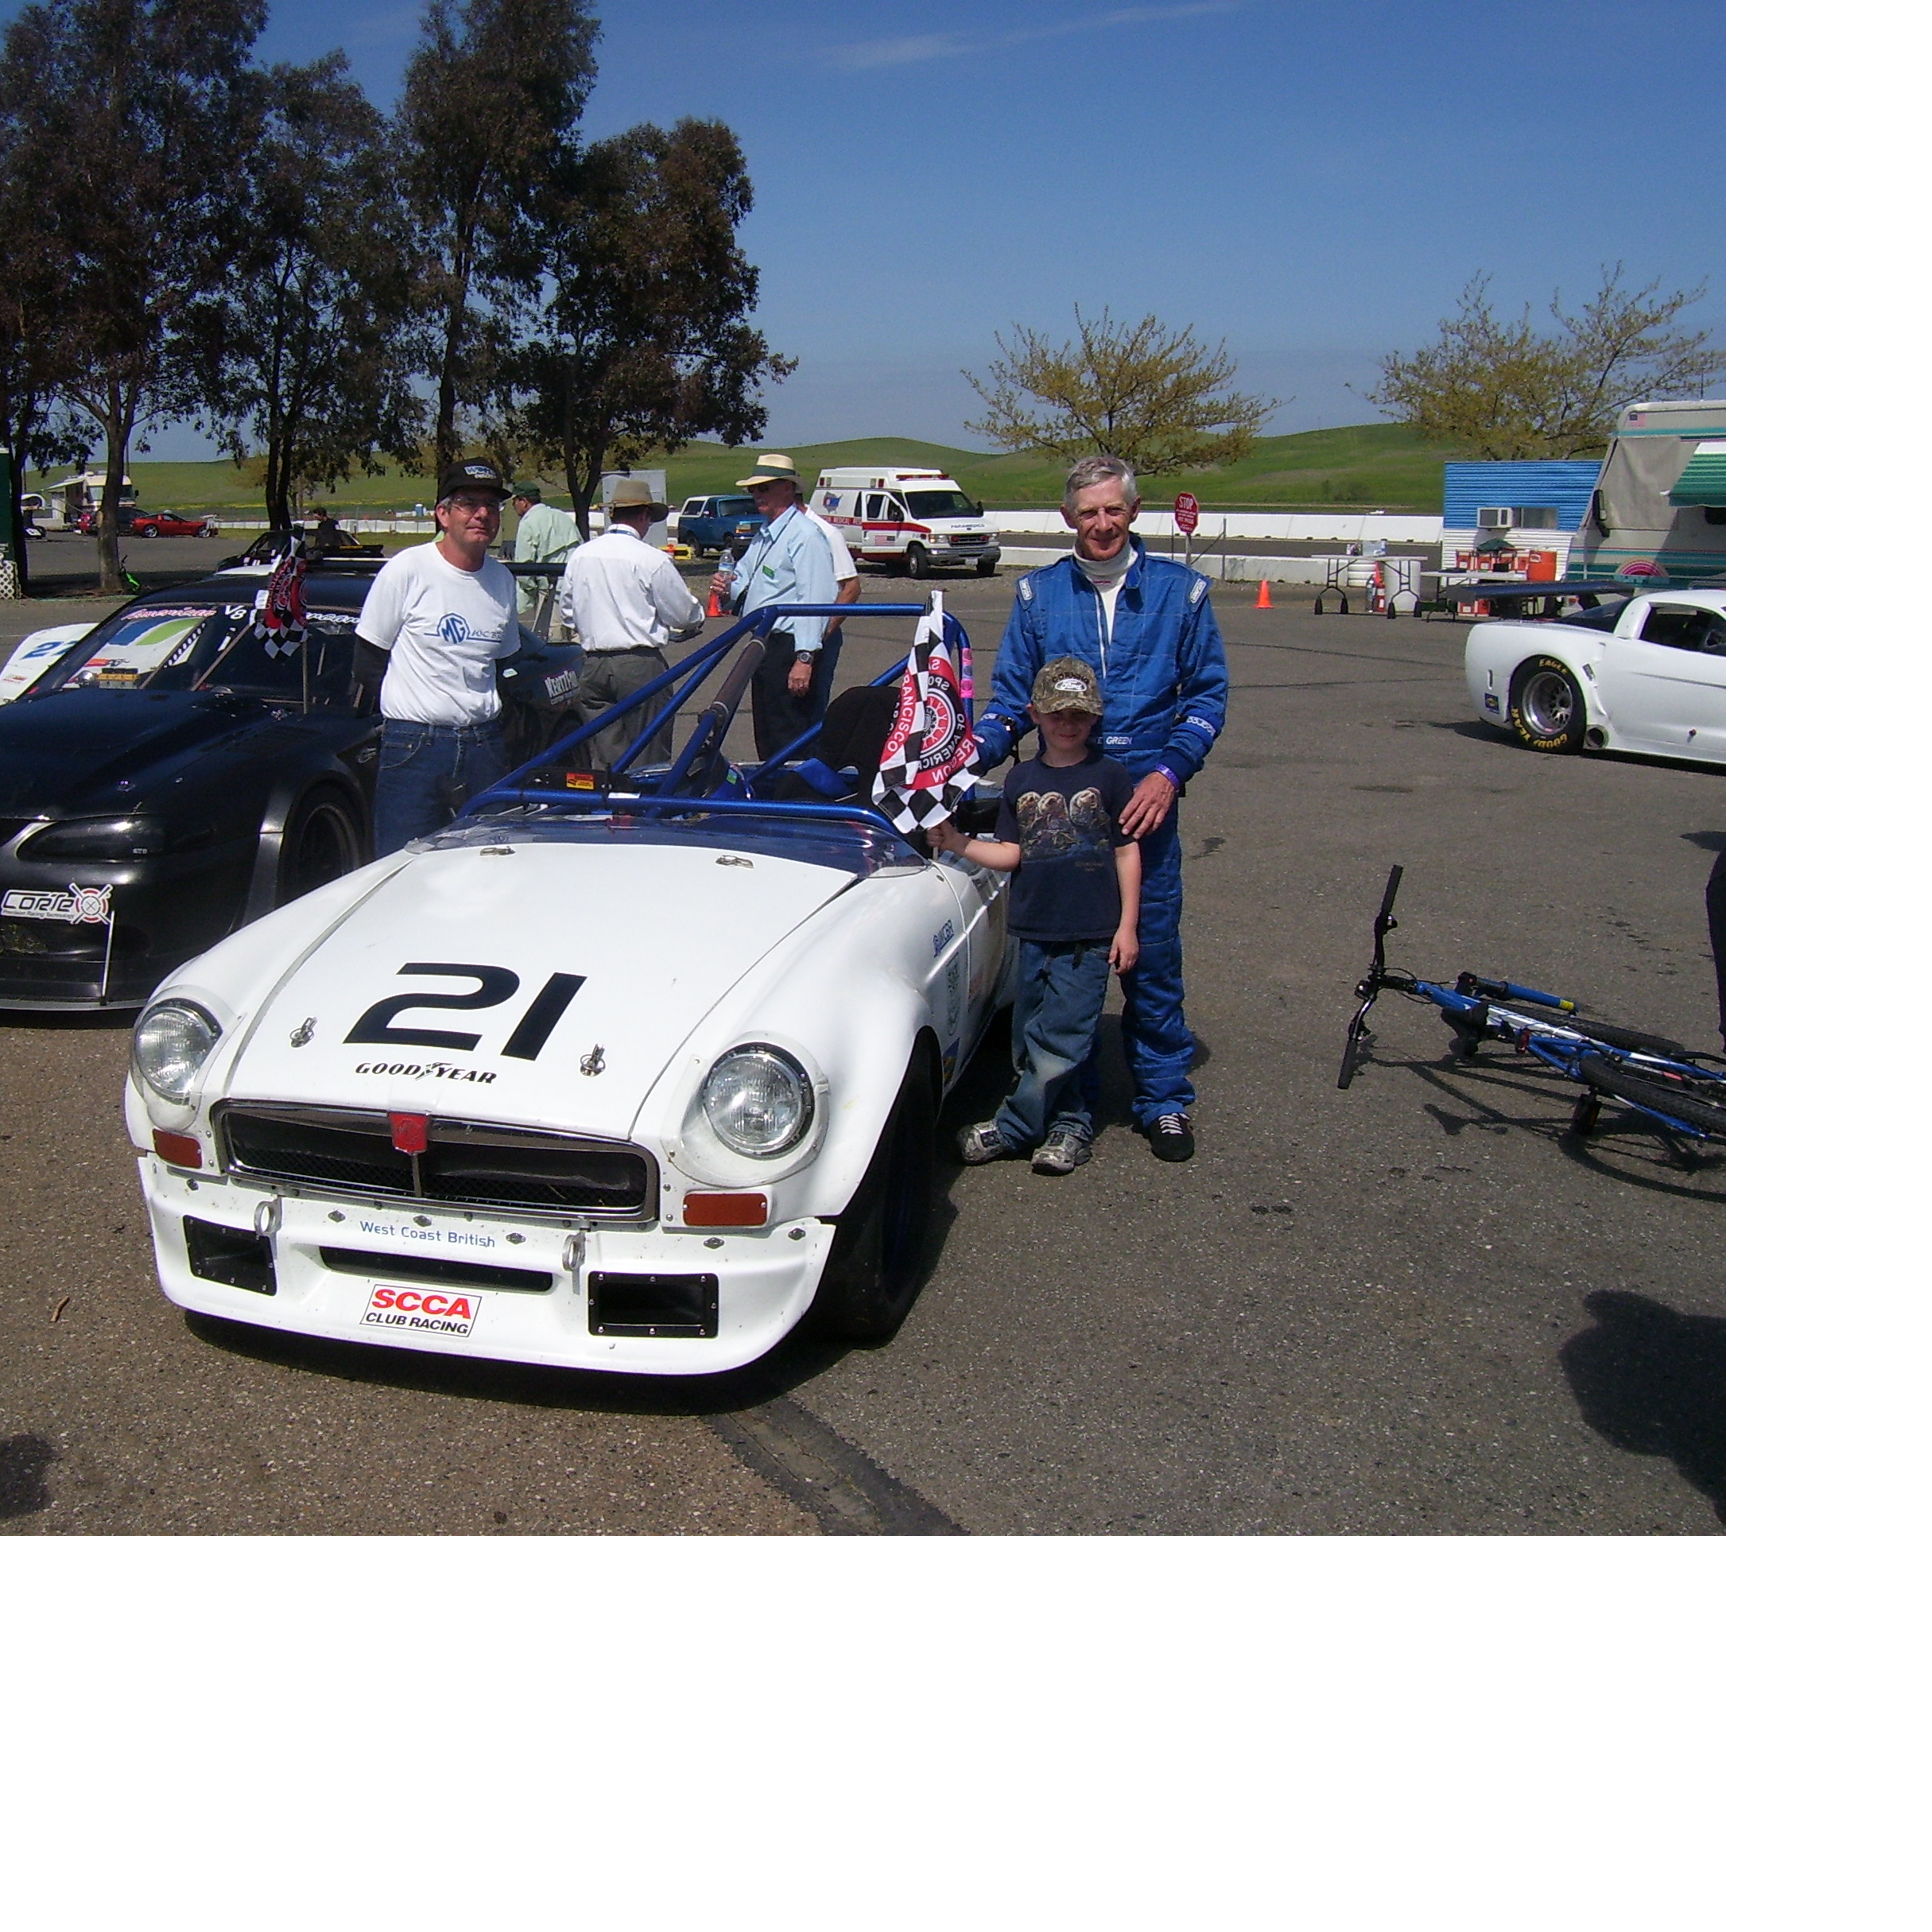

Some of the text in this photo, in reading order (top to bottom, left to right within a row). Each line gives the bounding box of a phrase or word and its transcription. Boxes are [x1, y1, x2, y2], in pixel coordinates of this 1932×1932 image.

[1179, 496, 1194, 510] STOP
[225, 605, 247, 619] V8
[441, 617, 466, 644] MG
[1539, 659, 1567, 674] EAGLE
[342, 962, 588, 1062] 21
[360, 1220, 496, 1248] West Coast British
[371, 1288, 472, 1320] SCCA
[365, 1312, 470, 1335] CLUB RACING
